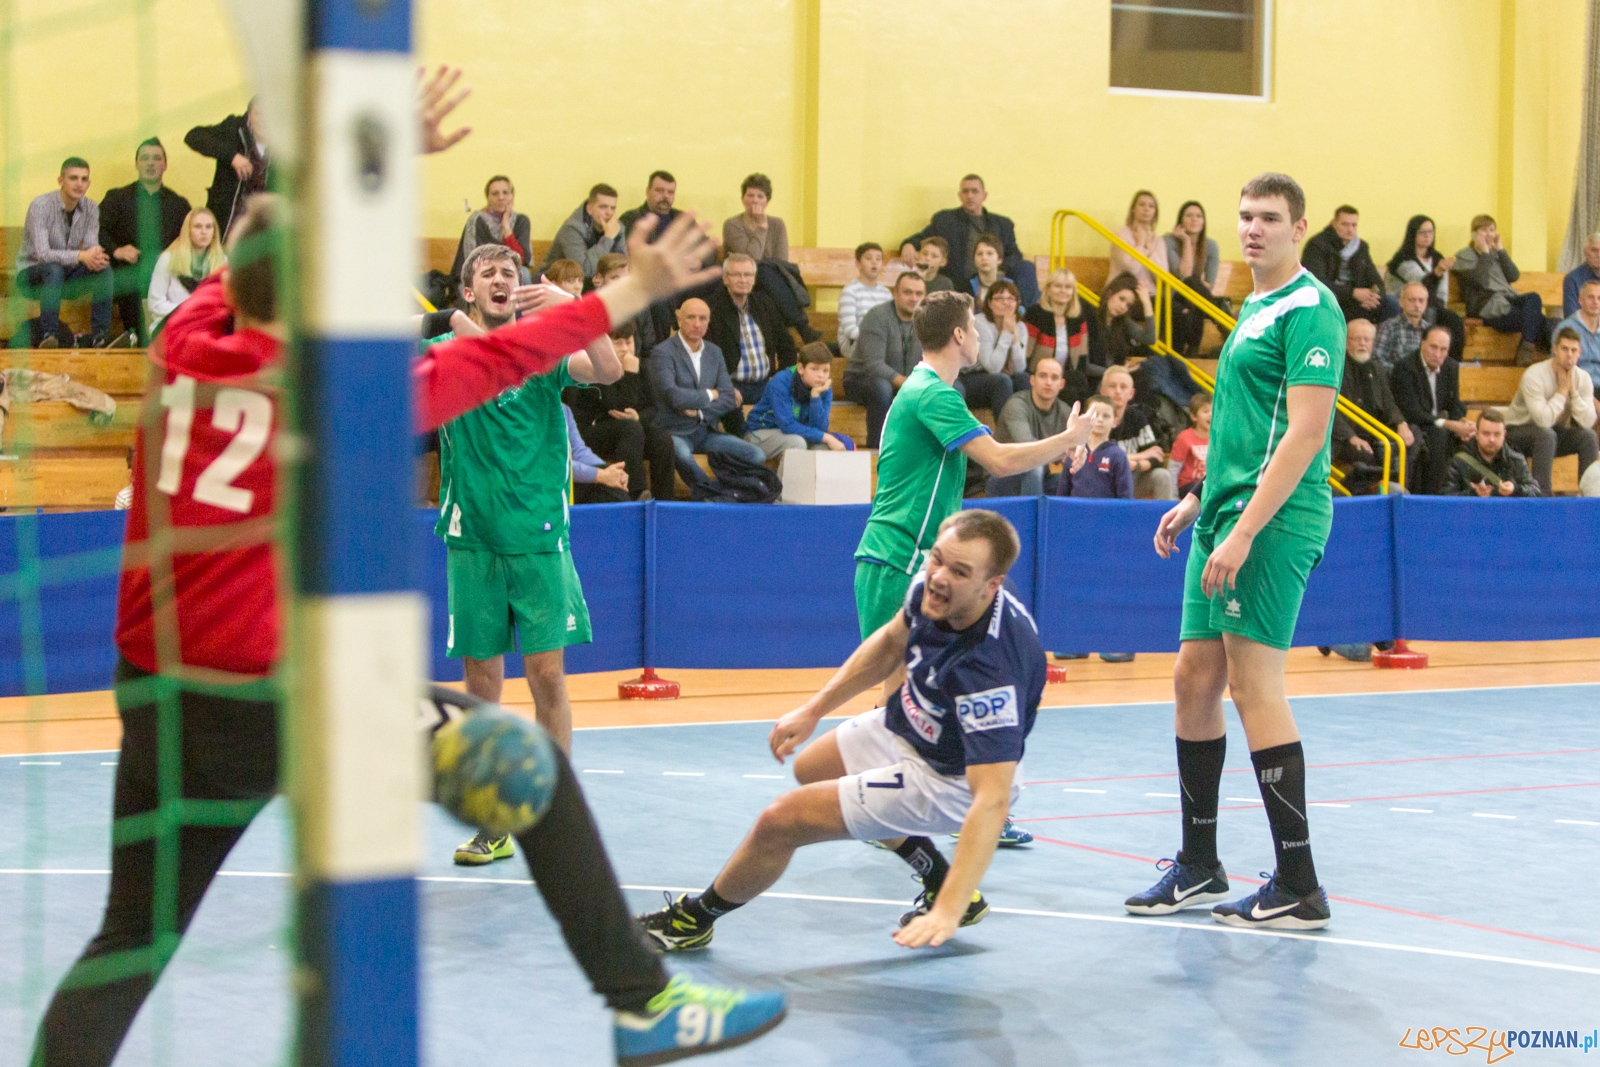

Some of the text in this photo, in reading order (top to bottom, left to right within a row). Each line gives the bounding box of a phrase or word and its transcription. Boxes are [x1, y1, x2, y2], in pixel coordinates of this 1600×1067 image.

[156, 374, 274, 514] 12
[958, 696, 1006, 720] PDP
[675, 1003, 726, 1049] 91
